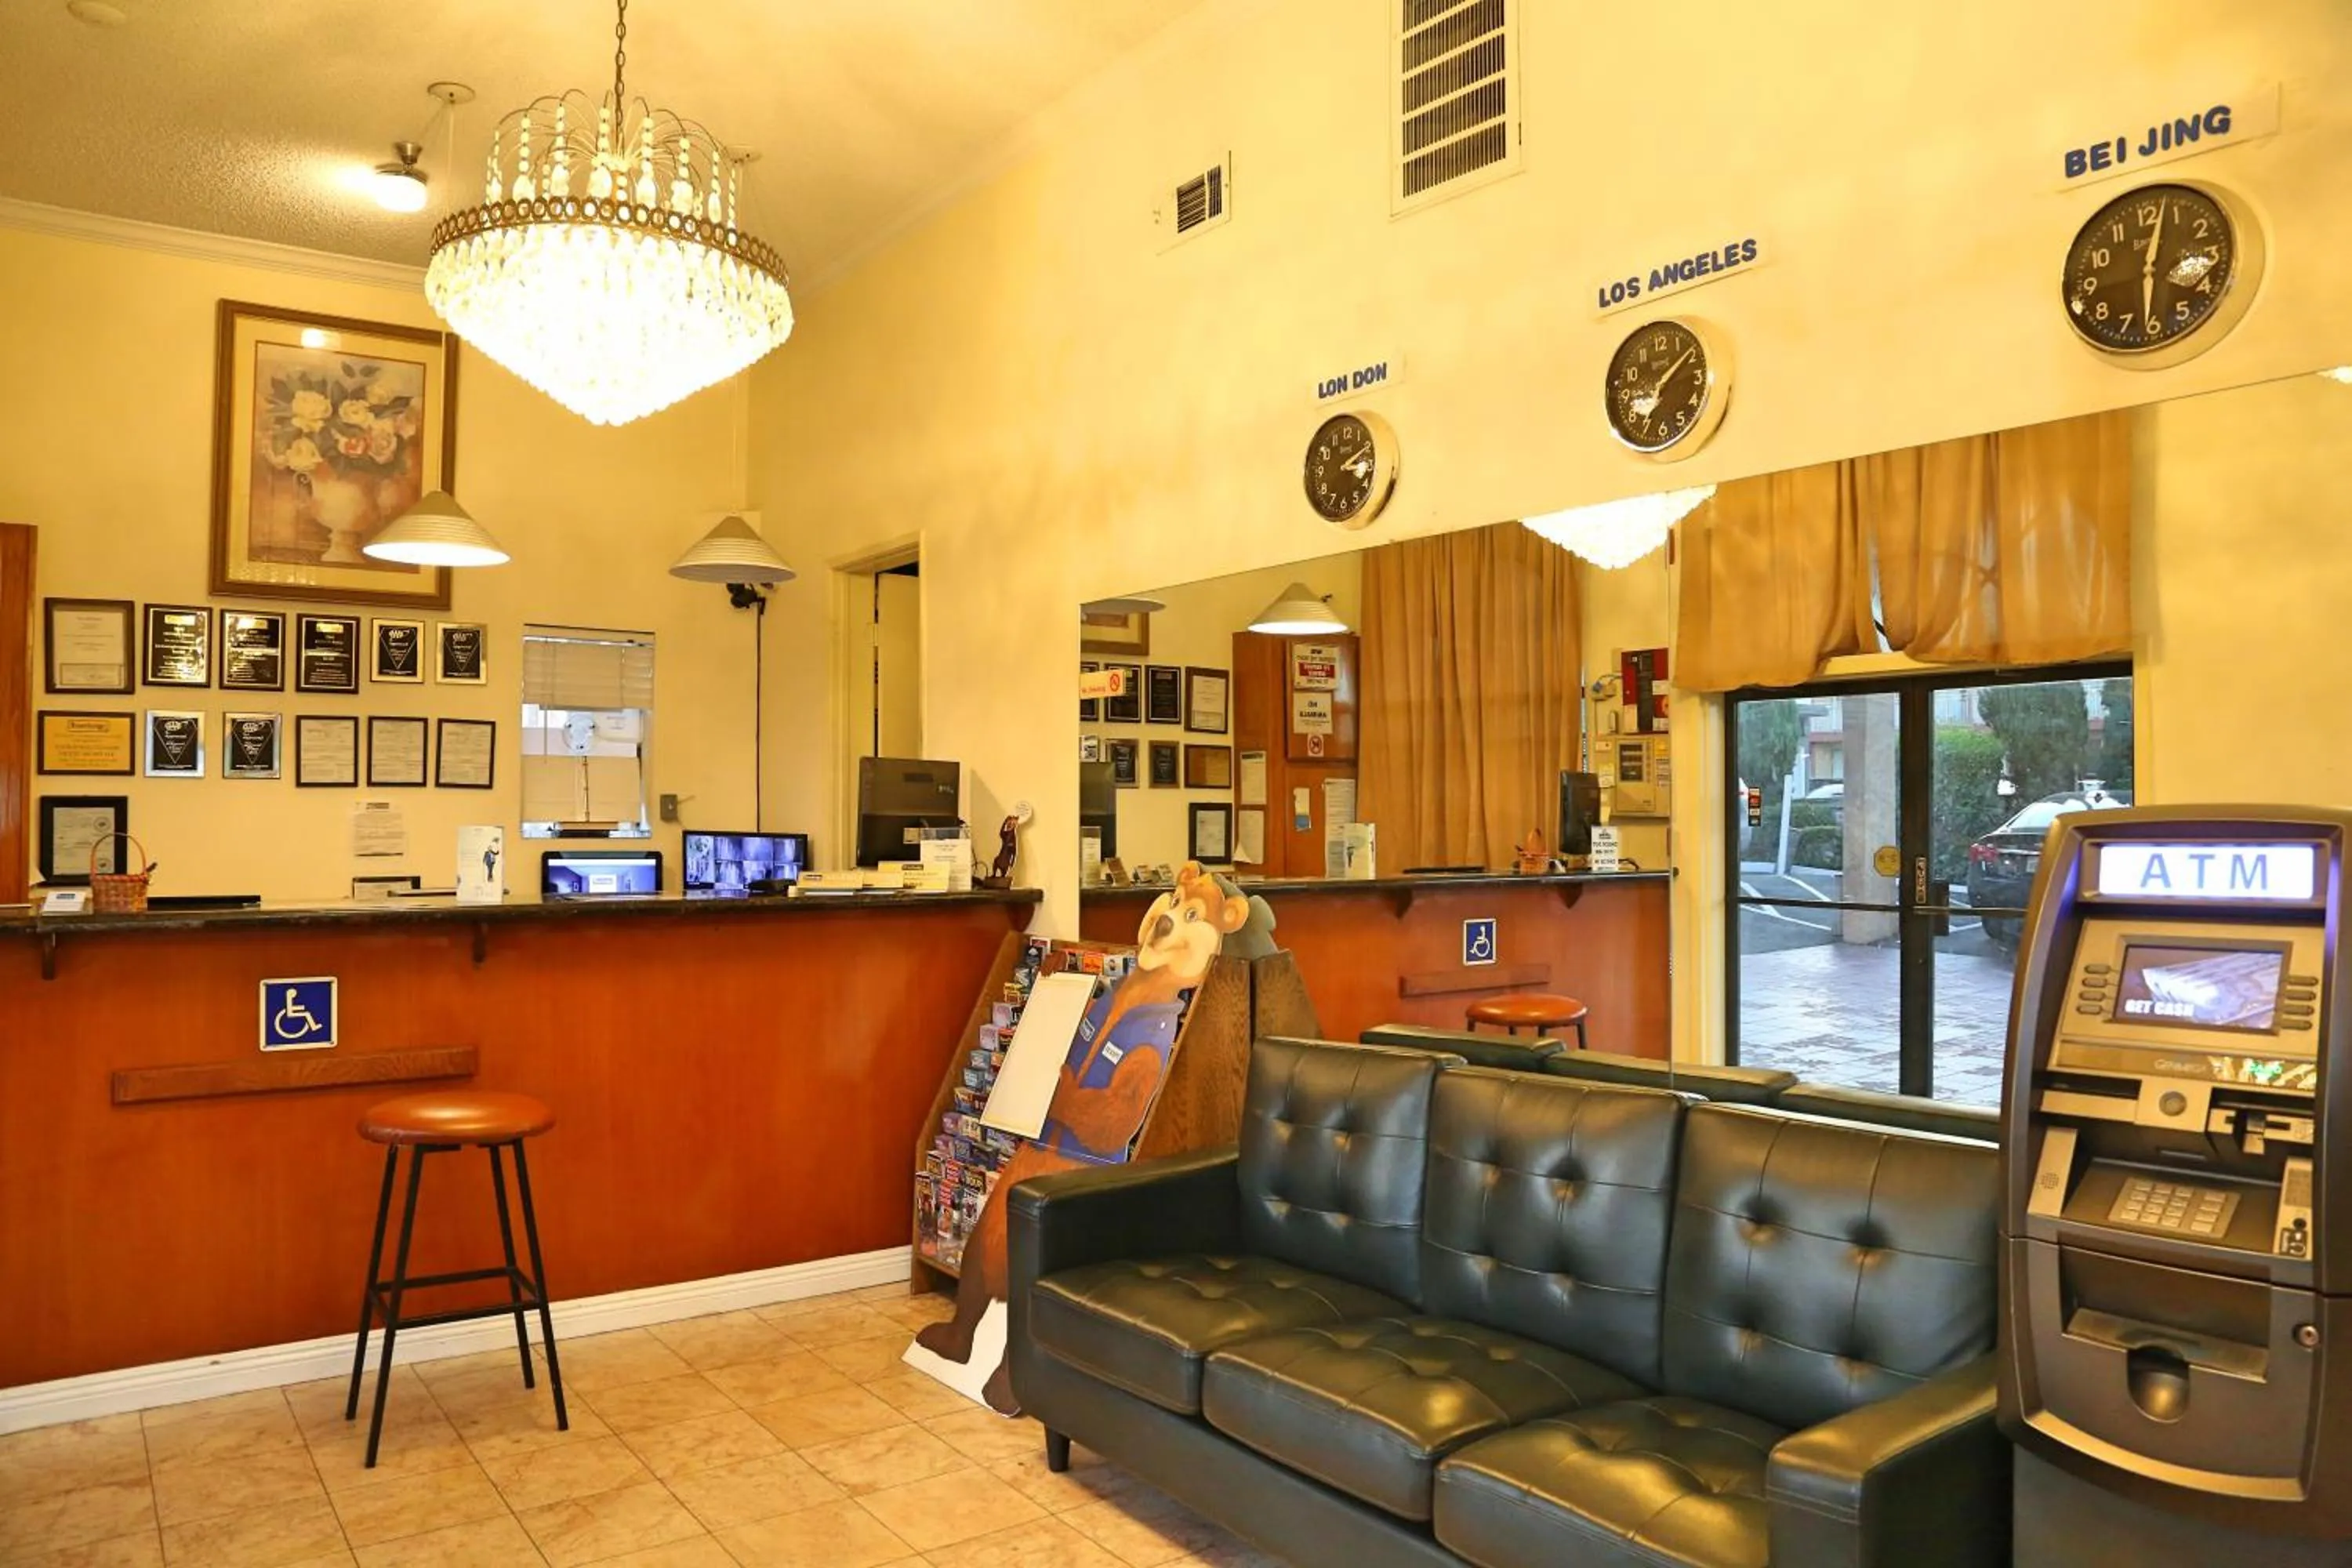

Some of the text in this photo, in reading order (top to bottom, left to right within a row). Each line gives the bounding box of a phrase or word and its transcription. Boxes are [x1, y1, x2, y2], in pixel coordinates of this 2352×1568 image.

[2137, 205, 2158, 227] 12
[2173, 205, 2179, 225] 1
[2112, 223, 2124, 243] 11
[2193, 219, 2209, 239] 2
[2092, 249, 2111, 269] 10
[2205, 245, 2220, 266] 3
[1599, 238, 1757, 308] LOS ANGELES
[2083, 277, 2097, 296] 9
[2196, 276, 2211, 294] 4
[2095, 302, 2110, 321] 8
[2175, 300, 2190, 321] 5
[2119, 314, 2133, 333] 7
[2146, 315, 2161, 336] 6
[1655, 336, 1668, 351] 12
[1626, 366, 1638, 383] 10
[1693, 369, 1702, 385] 3
[1621, 388, 1630, 404] 9
[1688, 390, 1698, 407] 4
[1628, 408, 1636, 423] 8
[1675, 410, 1685, 426] 5
[1658, 421, 1668, 437] 6
[2140, 852, 2268, 890] ATM
[2125, 999, 2194, 1017] GET CASH
